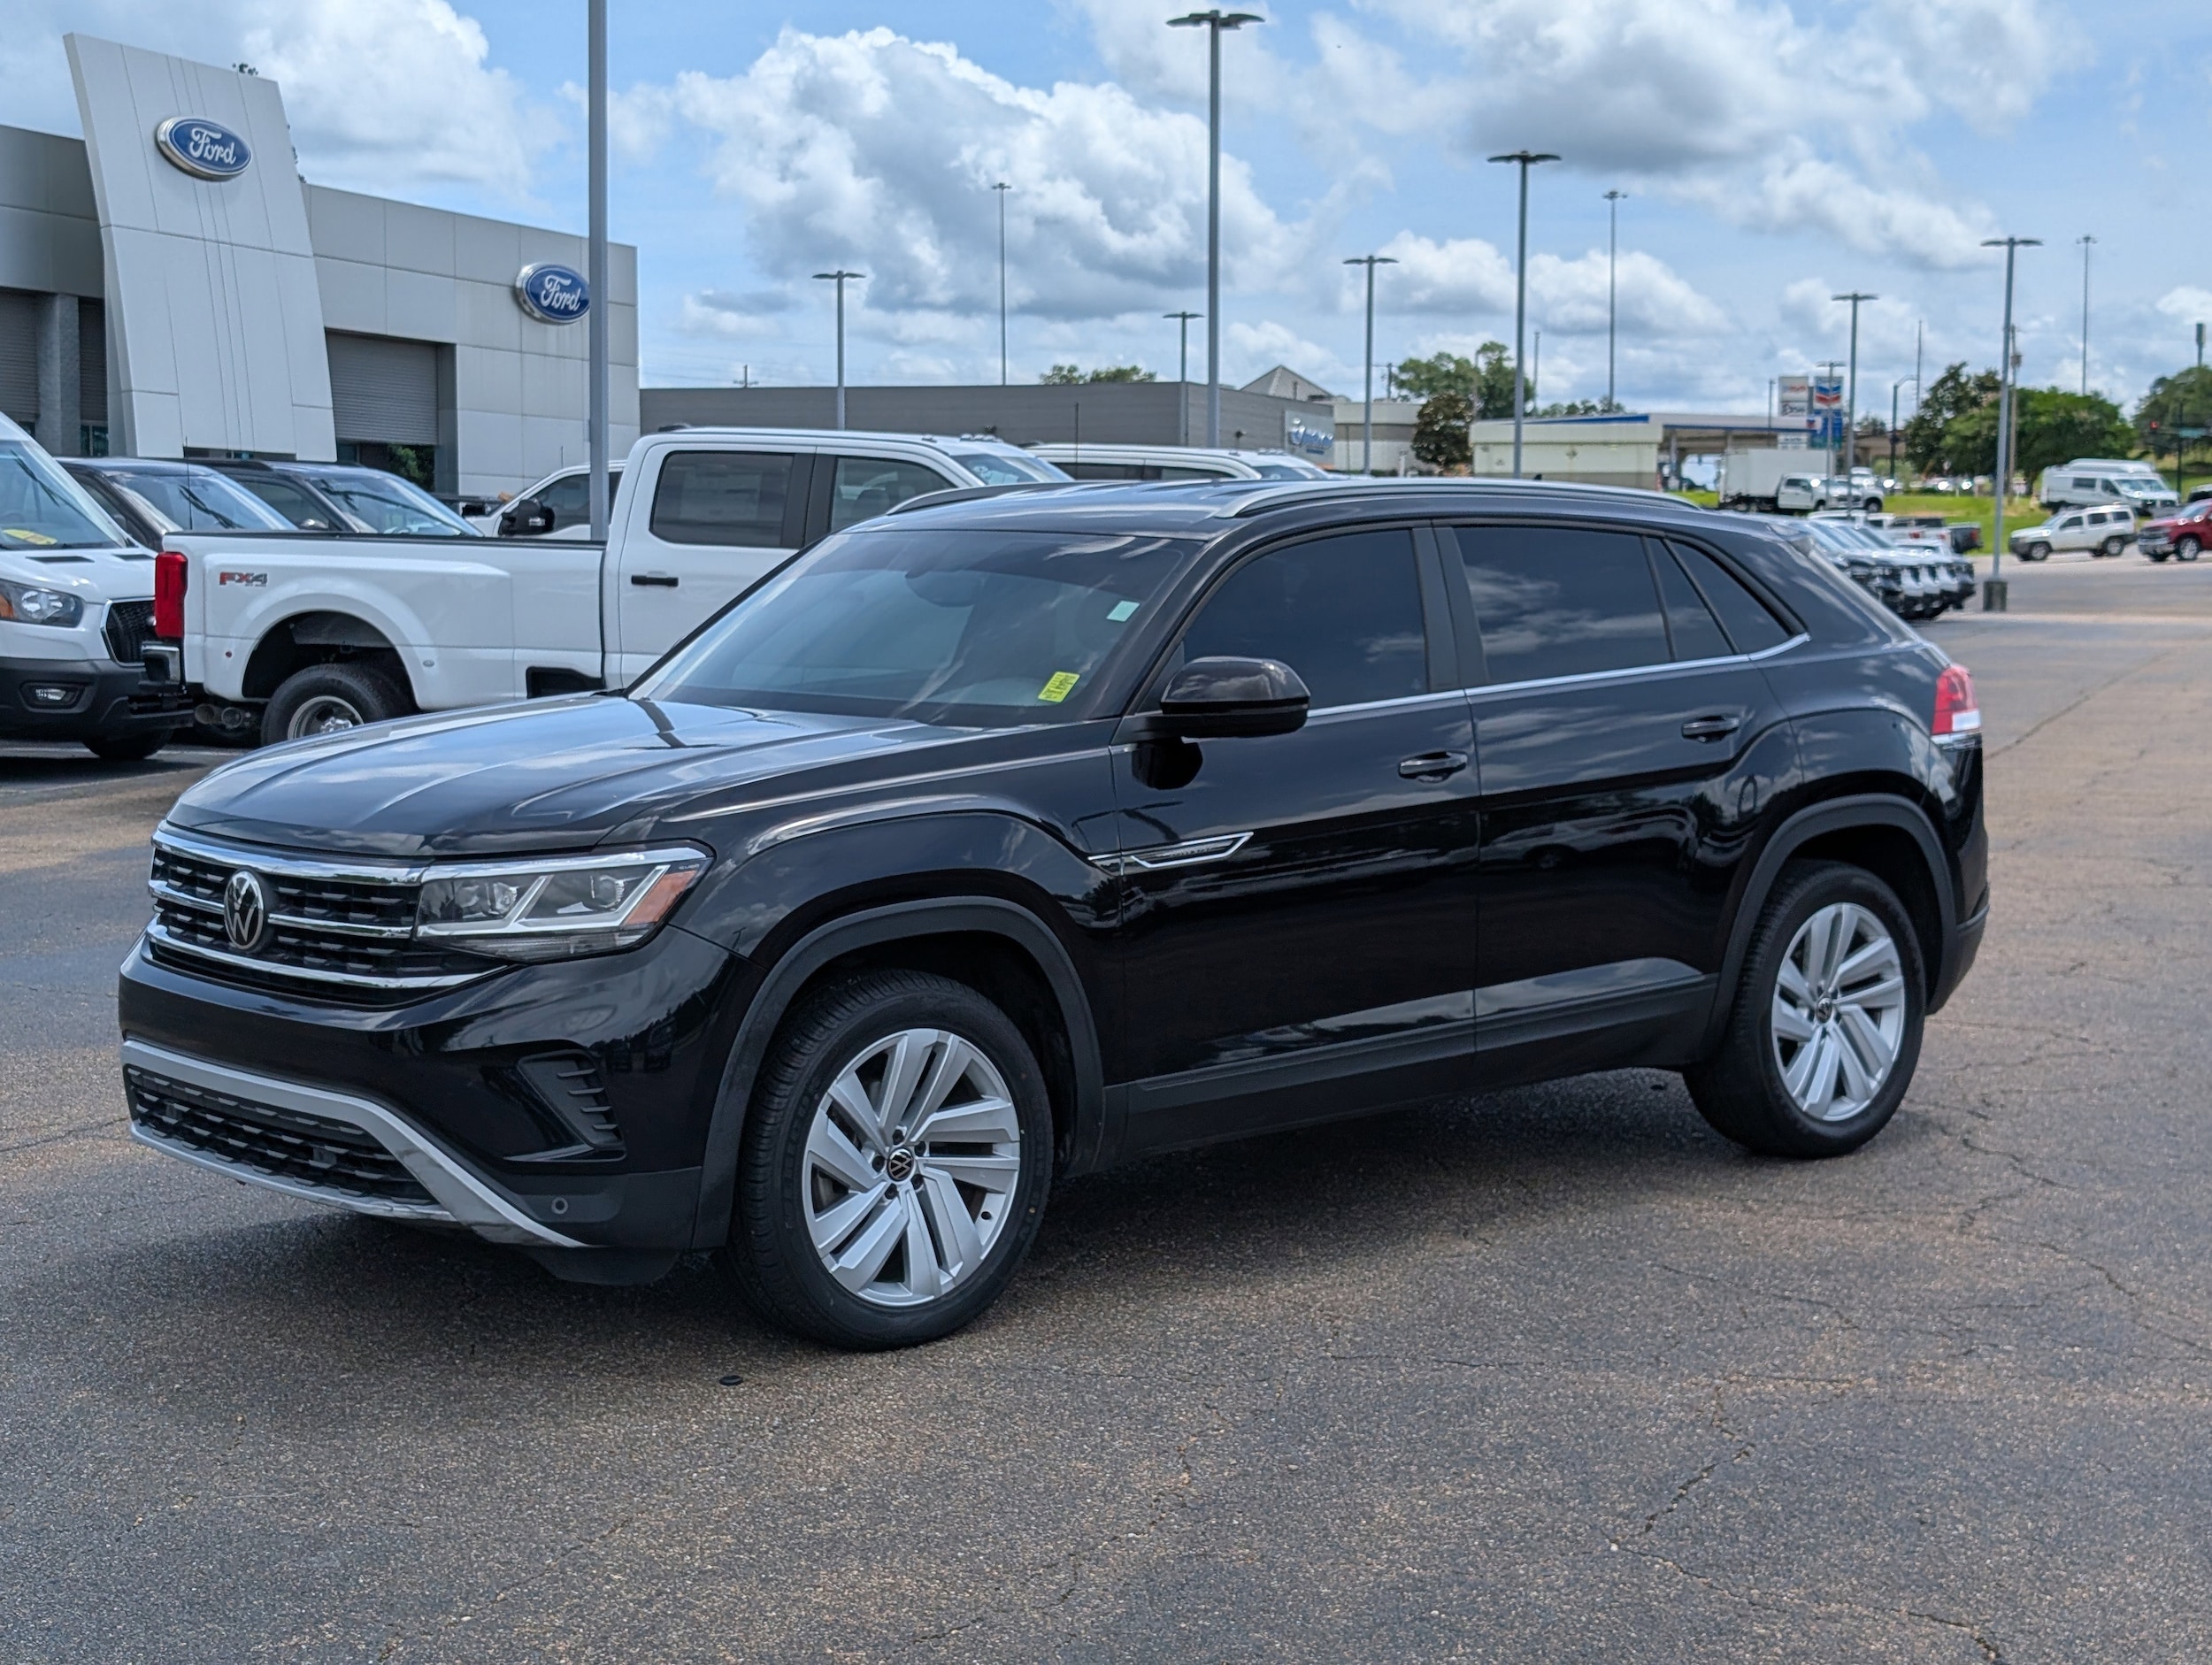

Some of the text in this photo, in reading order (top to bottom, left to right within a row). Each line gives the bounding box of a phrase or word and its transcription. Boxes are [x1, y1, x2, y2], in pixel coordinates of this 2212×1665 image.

[189, 127, 237, 165] Ford
[541, 275, 581, 312] Ford
[219, 572, 268, 586] FX4
